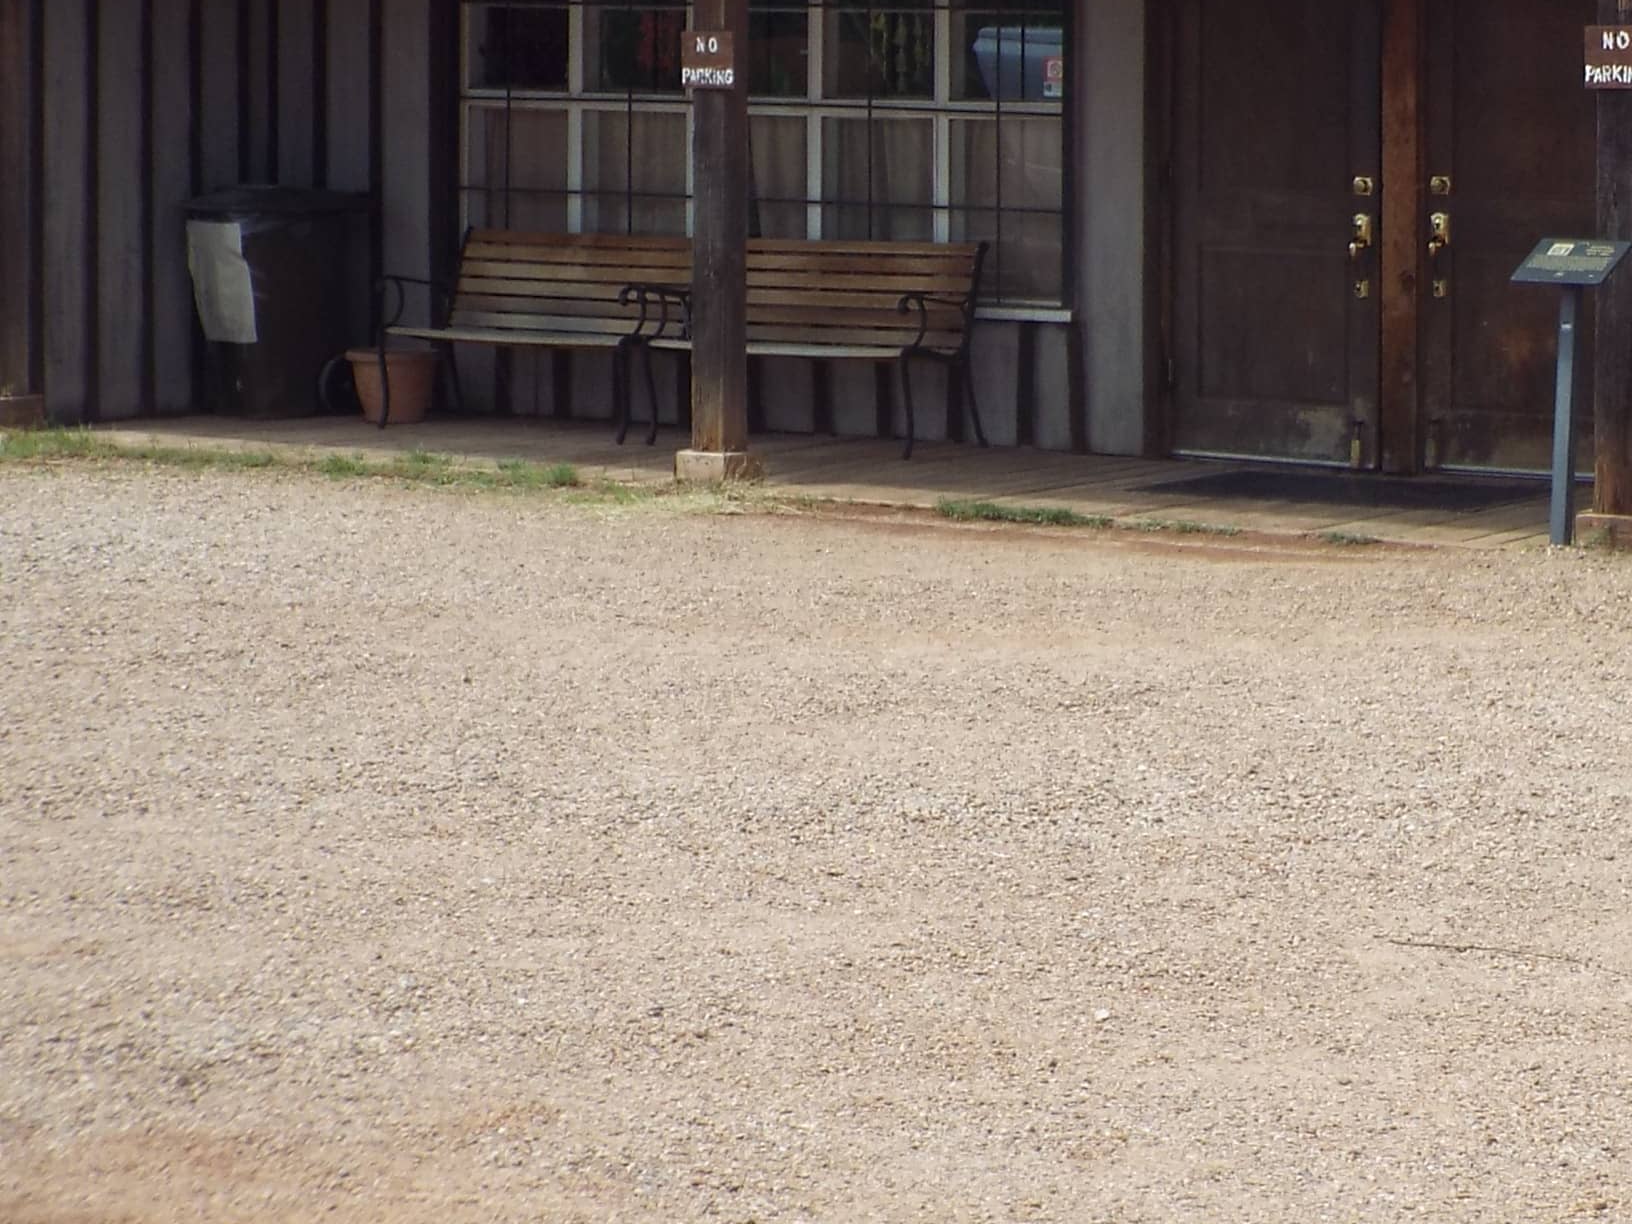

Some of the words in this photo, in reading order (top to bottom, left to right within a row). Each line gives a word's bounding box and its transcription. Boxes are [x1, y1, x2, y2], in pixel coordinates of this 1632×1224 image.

[696, 36, 718, 53] NO
[1602, 30, 1630, 50] NO
[682, 67, 733, 85] PARKING
